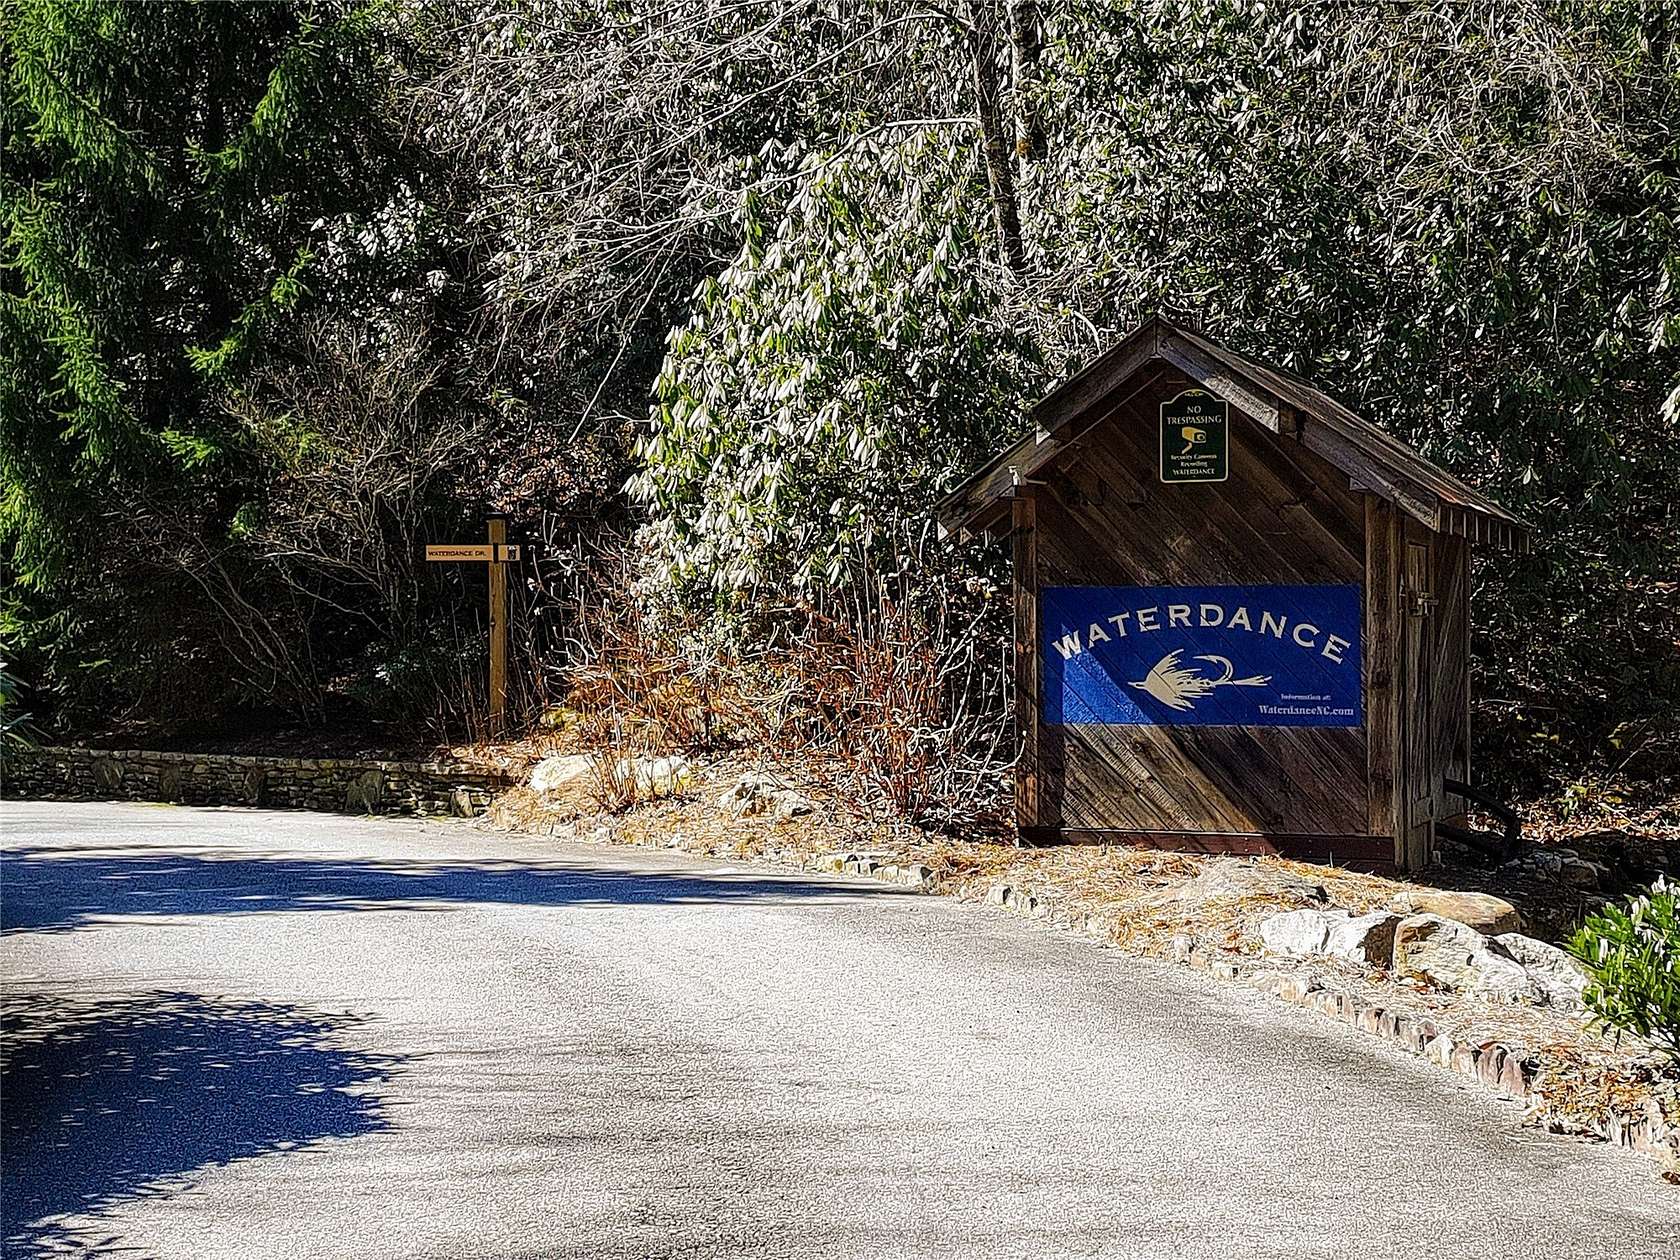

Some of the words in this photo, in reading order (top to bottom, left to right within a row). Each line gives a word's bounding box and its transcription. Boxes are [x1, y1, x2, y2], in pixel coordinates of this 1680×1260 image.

[1187, 405, 1201, 414] NO
[1167, 415, 1222, 425] TRESPASSING
[1051, 604, 1351, 665] WATERDANCE
[1280, 693, 1321, 701] Information
[1258, 704, 1354, 716] WaterdanceNC.com
